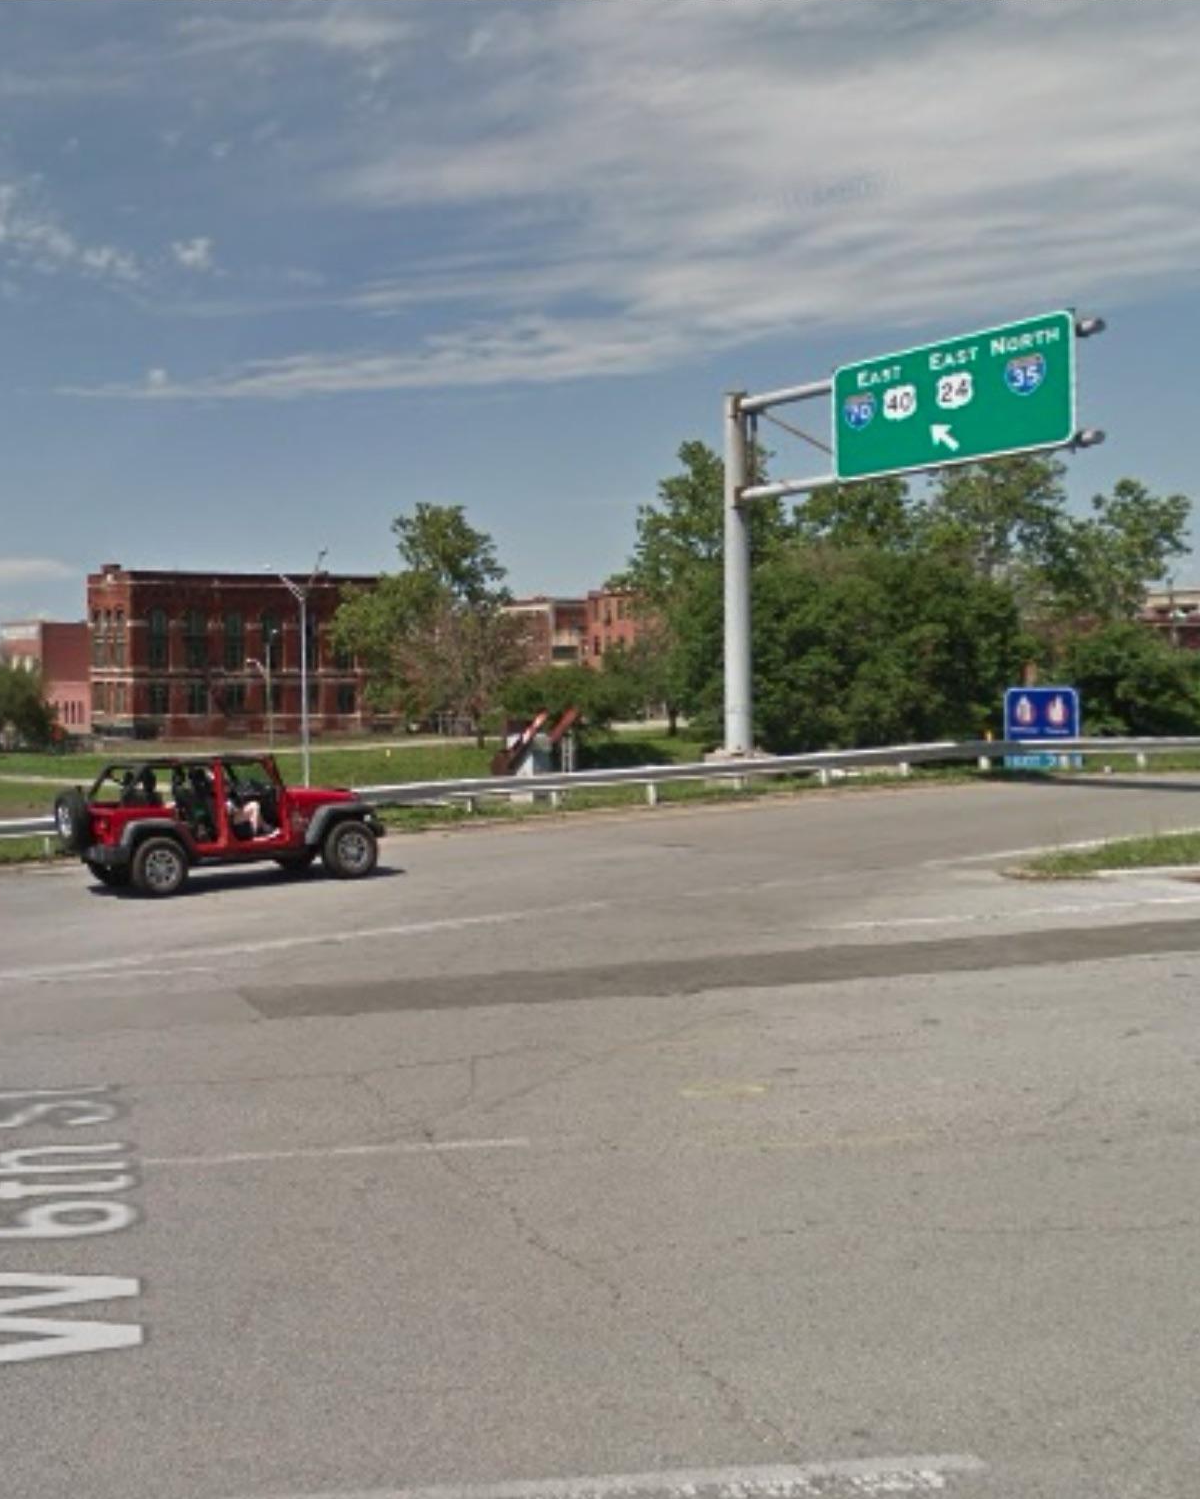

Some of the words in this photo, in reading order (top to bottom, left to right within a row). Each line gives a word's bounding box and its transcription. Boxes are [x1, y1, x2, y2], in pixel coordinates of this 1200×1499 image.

[856, 365, 902, 389] EAST
[928, 346, 979, 370] EAST
[989, 327, 1061, 357] NORTH
[886, 391, 914, 415] 40
[940, 378, 970, 404] 24
[1011, 366, 1040, 388] 35
